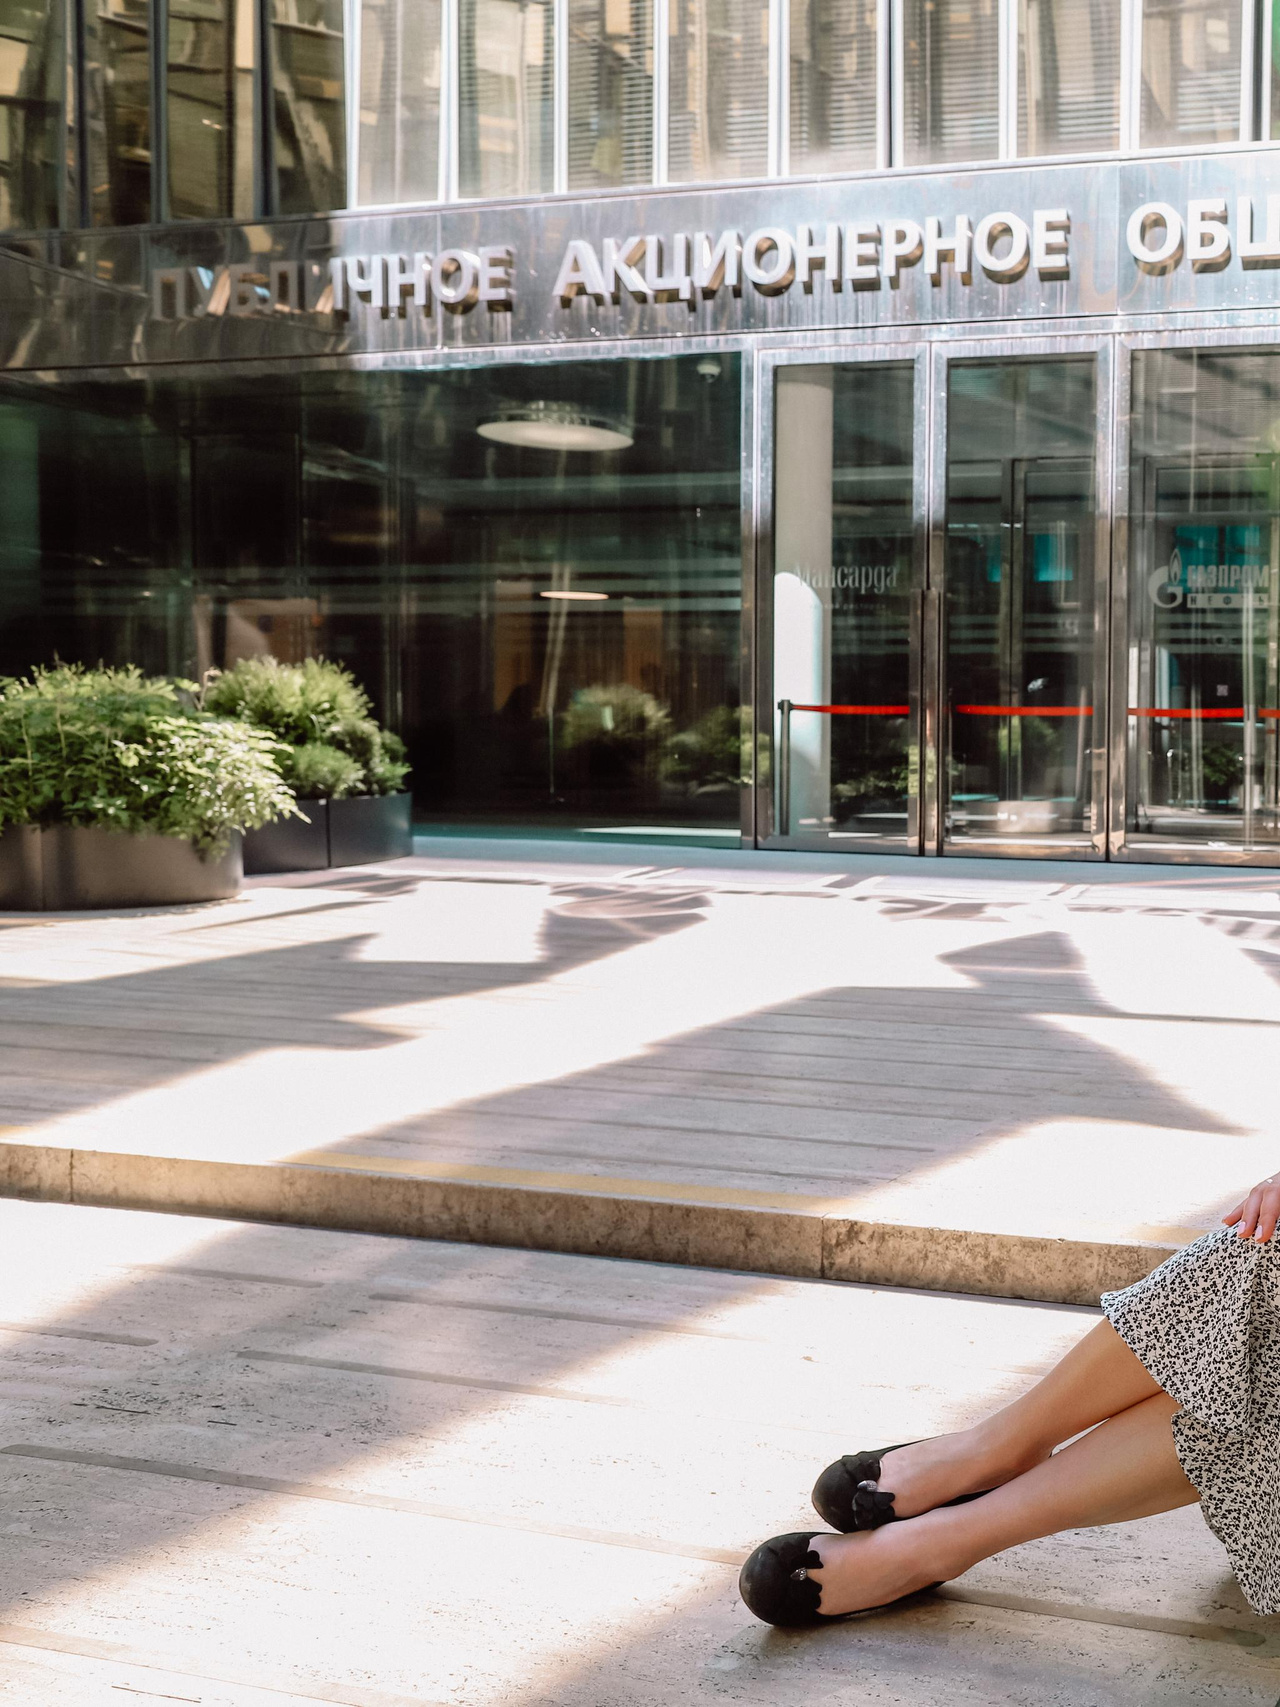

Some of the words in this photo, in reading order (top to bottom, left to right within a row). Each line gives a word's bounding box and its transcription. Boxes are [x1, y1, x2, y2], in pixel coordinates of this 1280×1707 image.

[552, 208, 1071, 310] АКЦИОНЕРНОЕ
[1187, 564, 1270, 588] ГАЗПРОМ
[1189, 594, 1266, 607] НЕФЬ
